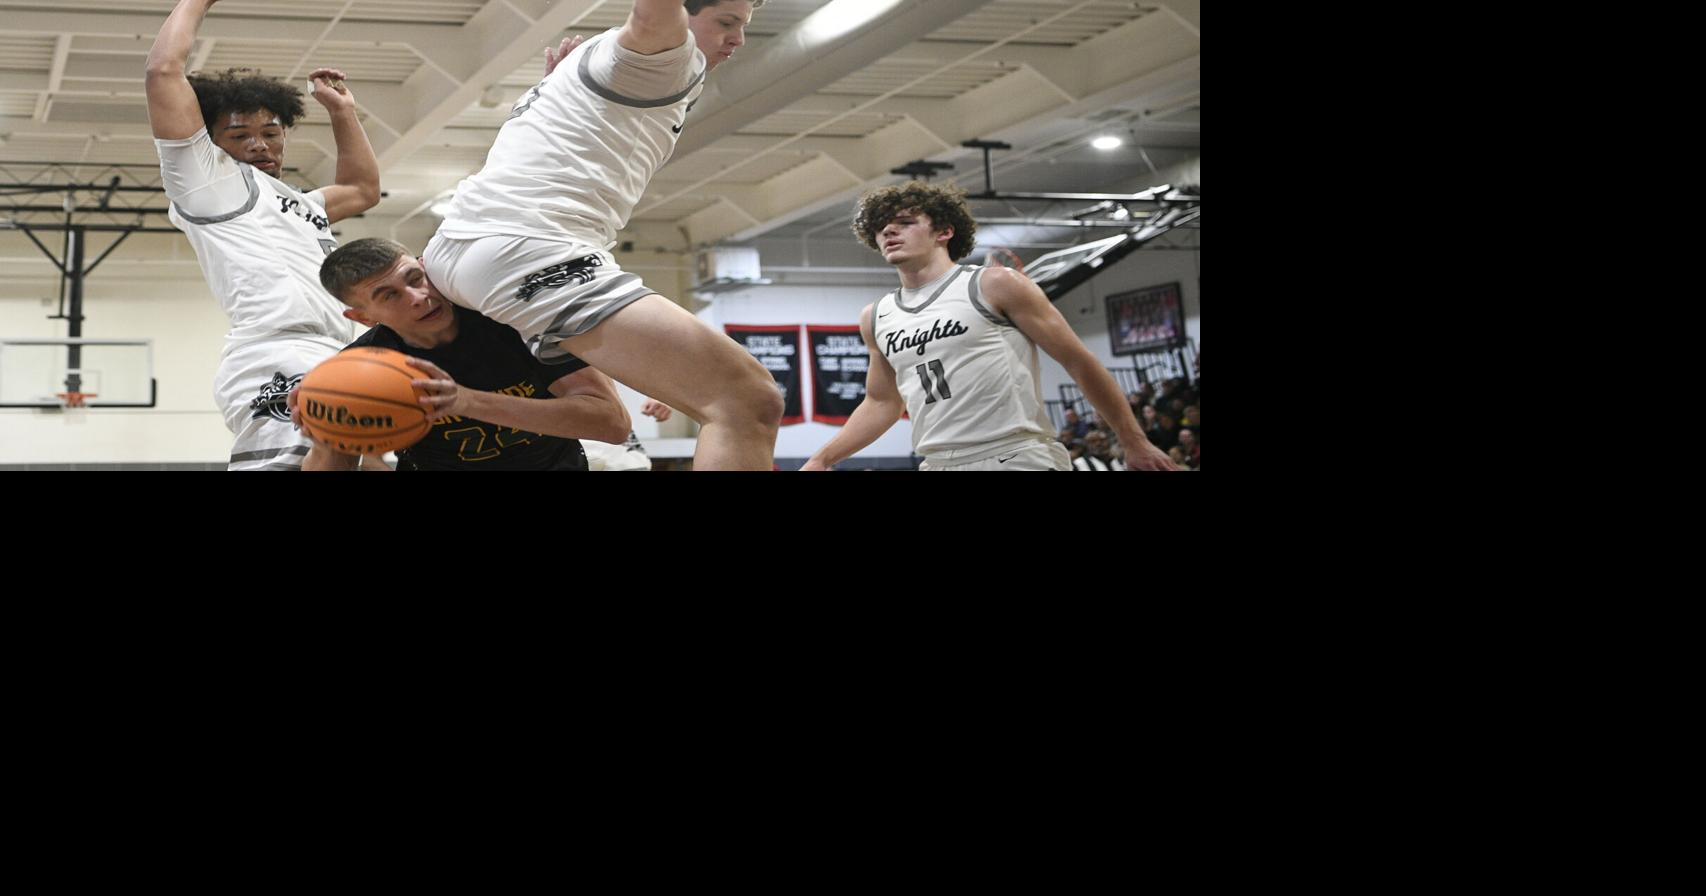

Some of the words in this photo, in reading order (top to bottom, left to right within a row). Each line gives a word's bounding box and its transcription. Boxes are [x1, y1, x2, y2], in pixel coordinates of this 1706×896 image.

[885, 319, 969, 357] Knights
[916, 358, 952, 405] 11
[306, 398, 394, 429] Wilson
